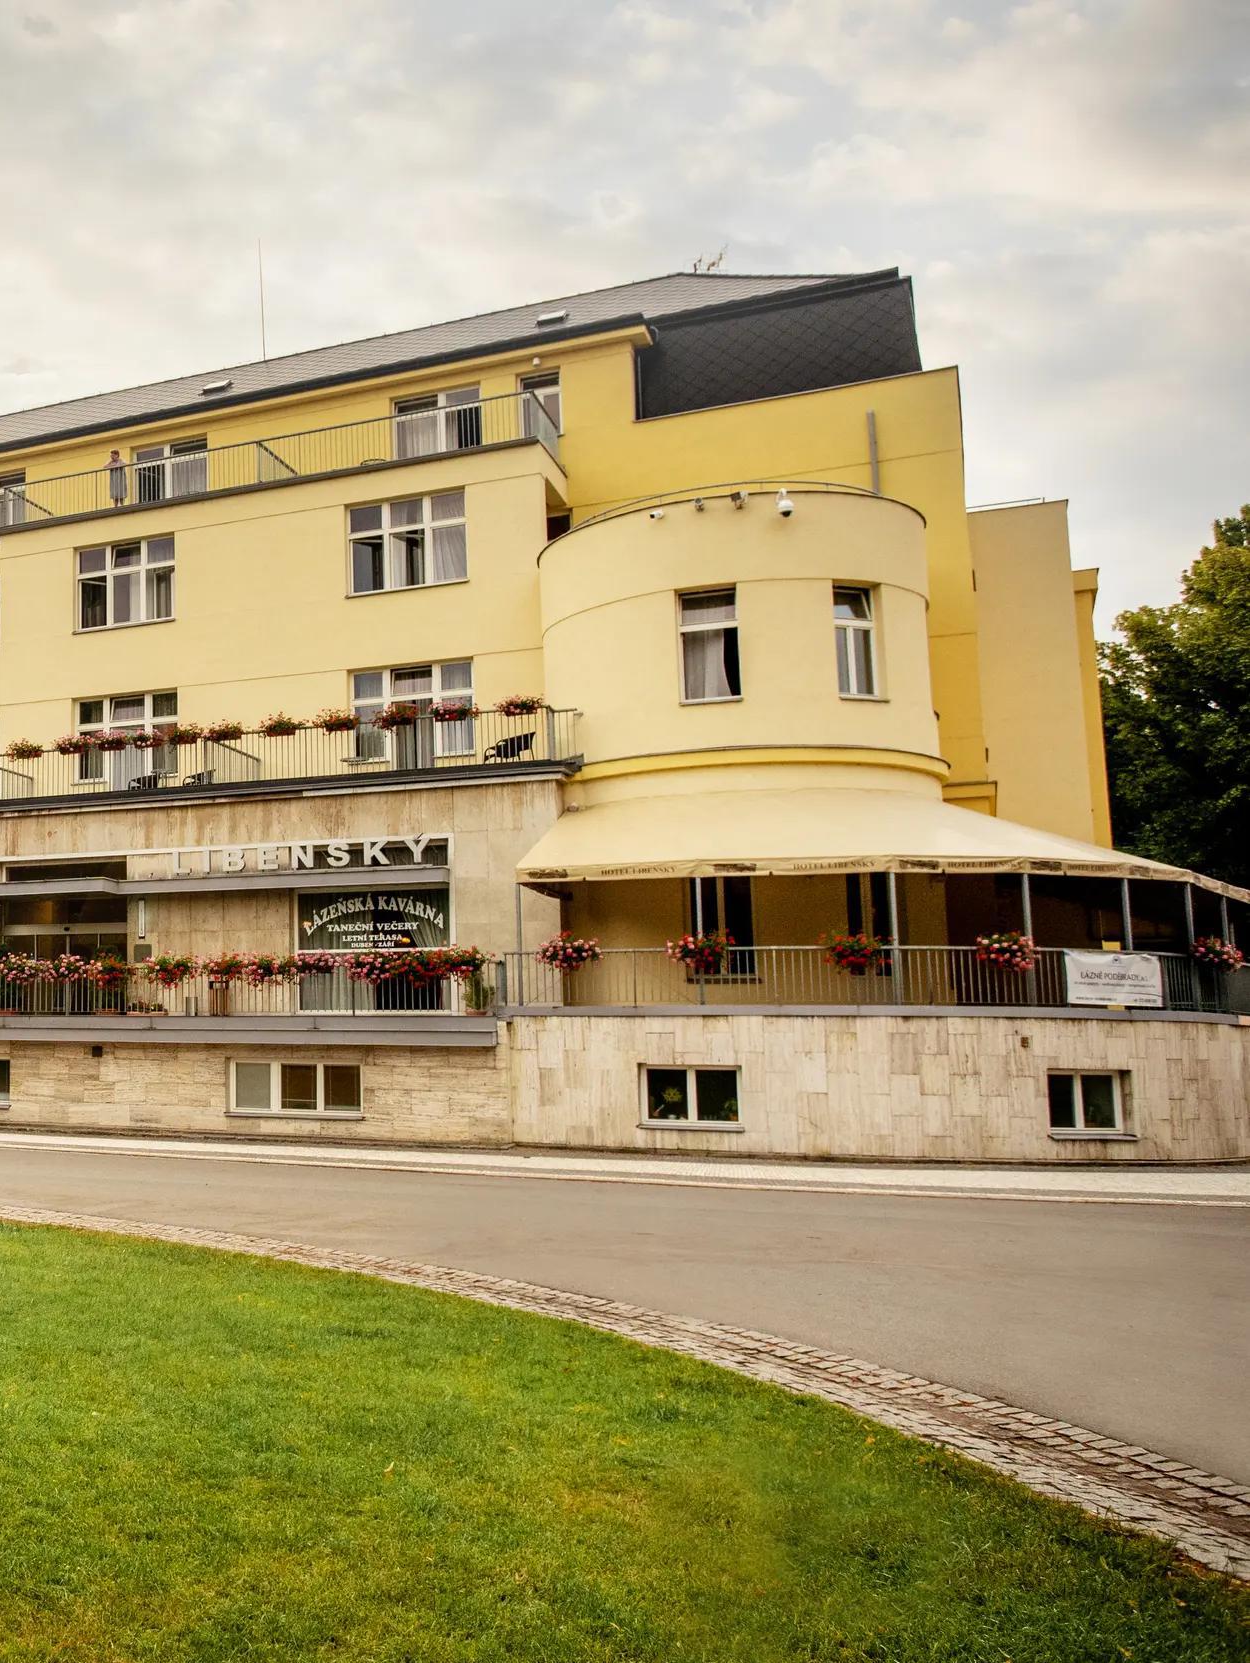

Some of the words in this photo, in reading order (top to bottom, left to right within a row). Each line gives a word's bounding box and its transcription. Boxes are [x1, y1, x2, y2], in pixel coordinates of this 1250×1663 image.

[172, 833, 431, 875] LIBENSKÝ
[304, 893, 375, 936] LÁZEŇSKÁ
[378, 896, 444, 929] KAVÁRNA
[327, 921, 374, 932] TANEČNÍ
[377, 921, 419, 931] VEČERY
[342, 933, 367, 942] LETNÍ
